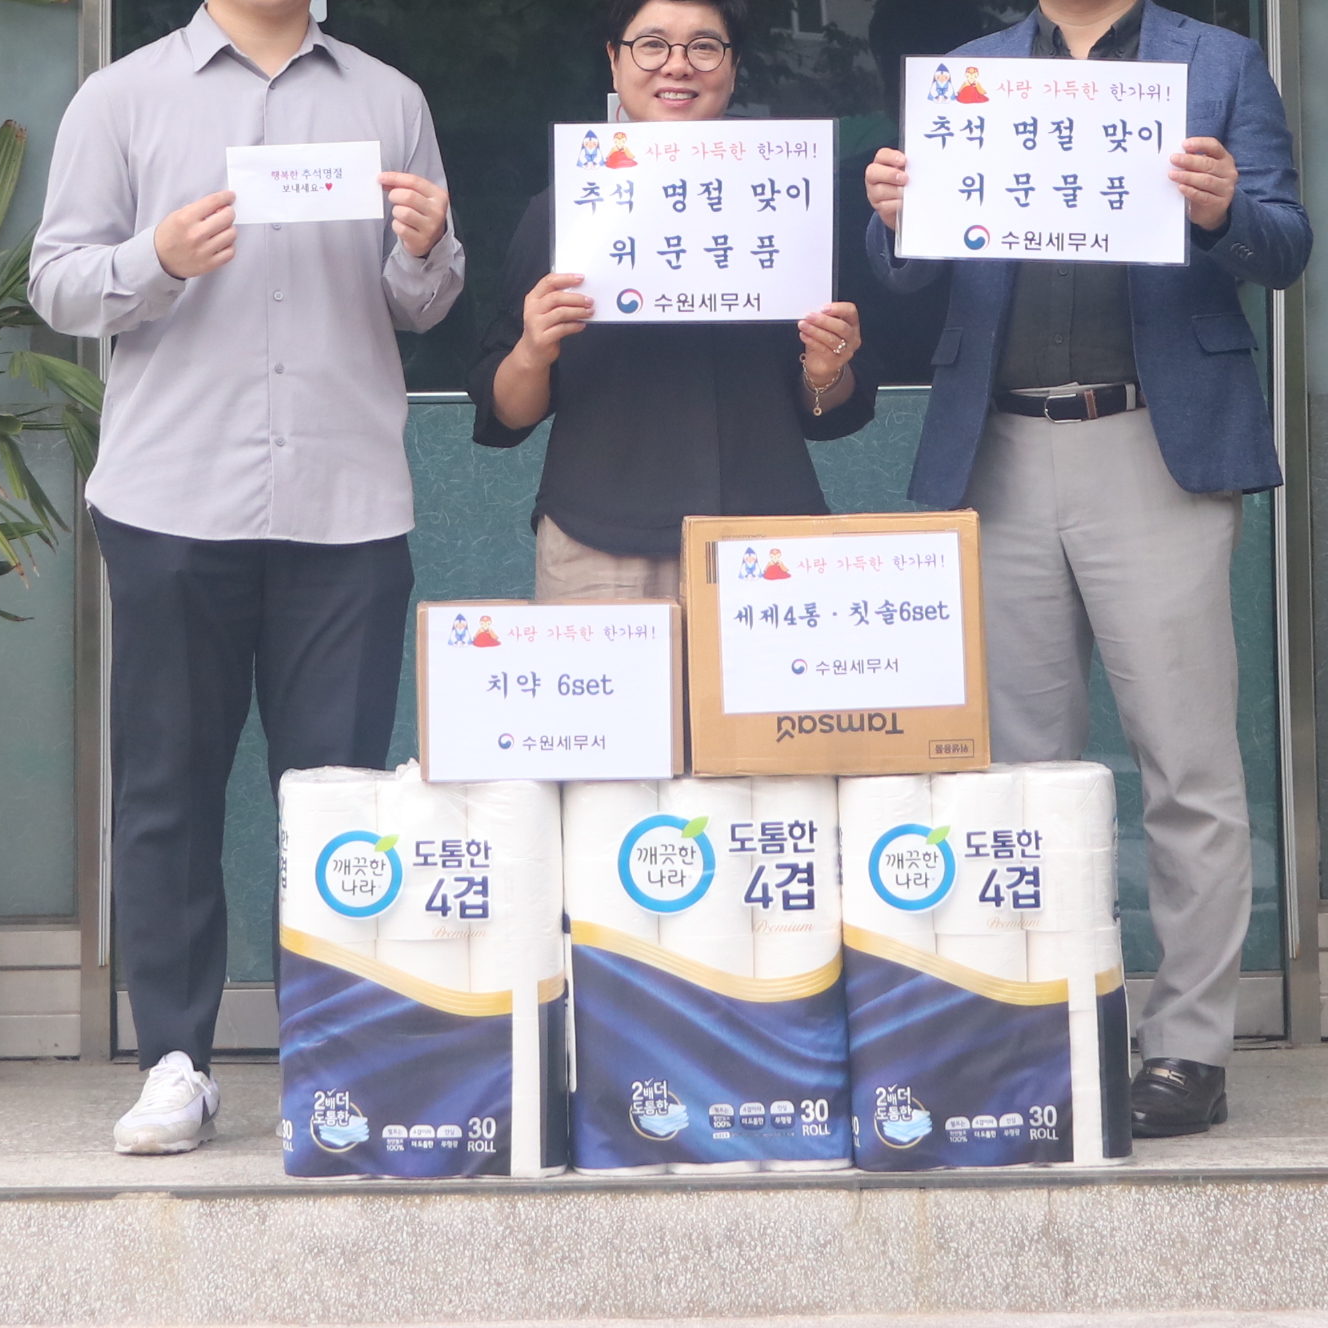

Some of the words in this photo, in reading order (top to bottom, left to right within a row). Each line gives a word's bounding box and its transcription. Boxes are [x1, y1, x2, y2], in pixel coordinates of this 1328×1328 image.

[996, 80, 1032, 100] 사랑
[1043, 80, 1098, 101] 가득한
[1110, 82, 1171, 102] 한가위!
[924, 116, 985, 150] 추석
[1013, 116, 1074, 152] 명절
[1102, 119, 1162, 154] 맞이
[645, 142, 680, 162] 사랑
[691, 141, 746, 162] 가득한
[758, 141, 817, 161] 한가위!
[271, 170, 298, 180] 행복한
[574, 179, 634, 215] 추석
[662, 178, 722, 213] 명절
[751, 177, 810, 213] 맞이
[958, 172, 1130, 210] 위문물품
[609, 234, 780, 270] 위문물품
[1001, 231, 1109, 252] 수원세무서
[654, 292, 761, 312] 수원세무서
[797, 557, 827, 575] 사랑
[837, 555, 883, 572] 가득한
[893, 553, 945, 571] 한가위!
[734, 602, 821, 630] 세제4통
[508, 626, 537, 642] 사랑
[547, 625, 594, 642] 가득한
[603, 624, 656, 641] 한가위!
[815, 658, 899, 675] 수원세무서
[486, 671, 541, 700] 치약
[557, 673, 614, 696] 6set
[522, 735, 606, 751] 수원세무서
[728, 820, 818, 854] 도톰한
[964, 829, 1042, 859] 도톰한
[413, 839, 492, 868] 도톰한
[637, 844, 696, 866] 깨끗한
[885, 850, 938, 869] 깨끗한
[333, 857, 386, 876] 깨끗한
[341, 879, 376, 896] 나라
[647, 869, 686, 888] 나라
[744, 861, 815, 911] 4겹
[895, 872, 929, 889] 나라
[979, 866, 1041, 908] 4겹
[425, 876, 489, 919] 4겹
[753, 920, 815, 933] Premium
[313, 1110, 350, 1126] 도톰한
[631, 1099, 669, 1116] 도톰한
[801, 1099, 829, 1122] 30
[875, 1105, 912, 1121] 도톰한
[1029, 1105, 1057, 1127] 30
[468, 1117, 496, 1139] 30
[802, 1124, 831, 1136] ROLL
[1030, 1128, 1059, 1140] ROLL
[468, 1140, 496, 1152] ROLL
